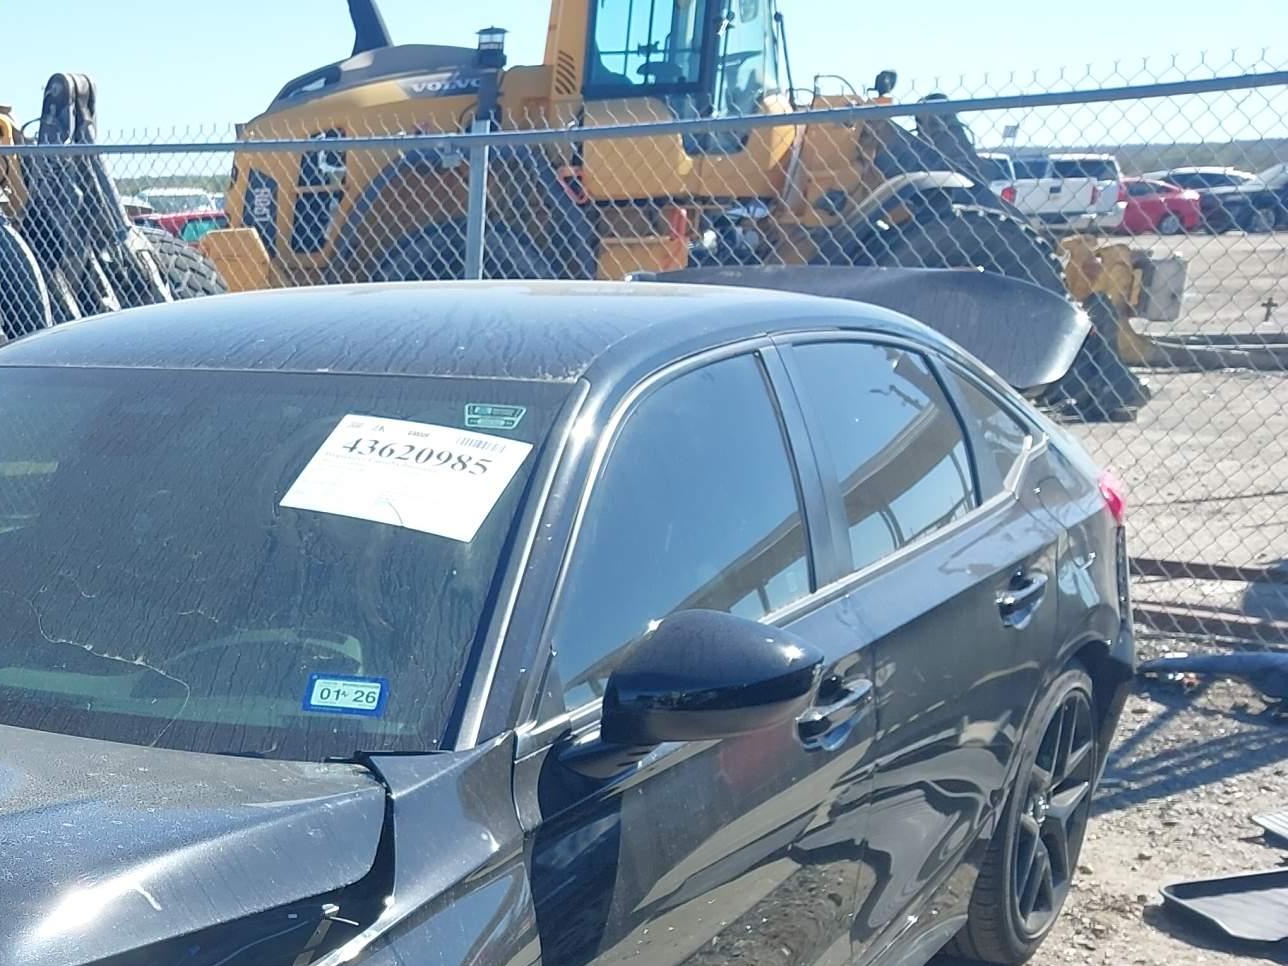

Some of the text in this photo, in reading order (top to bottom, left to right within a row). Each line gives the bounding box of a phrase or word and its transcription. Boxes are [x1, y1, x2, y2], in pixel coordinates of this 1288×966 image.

[412, 76, 480, 93] VOLVO
[342, 437, 493, 475] 43620985
[320, 687, 376, 704] 01 26
